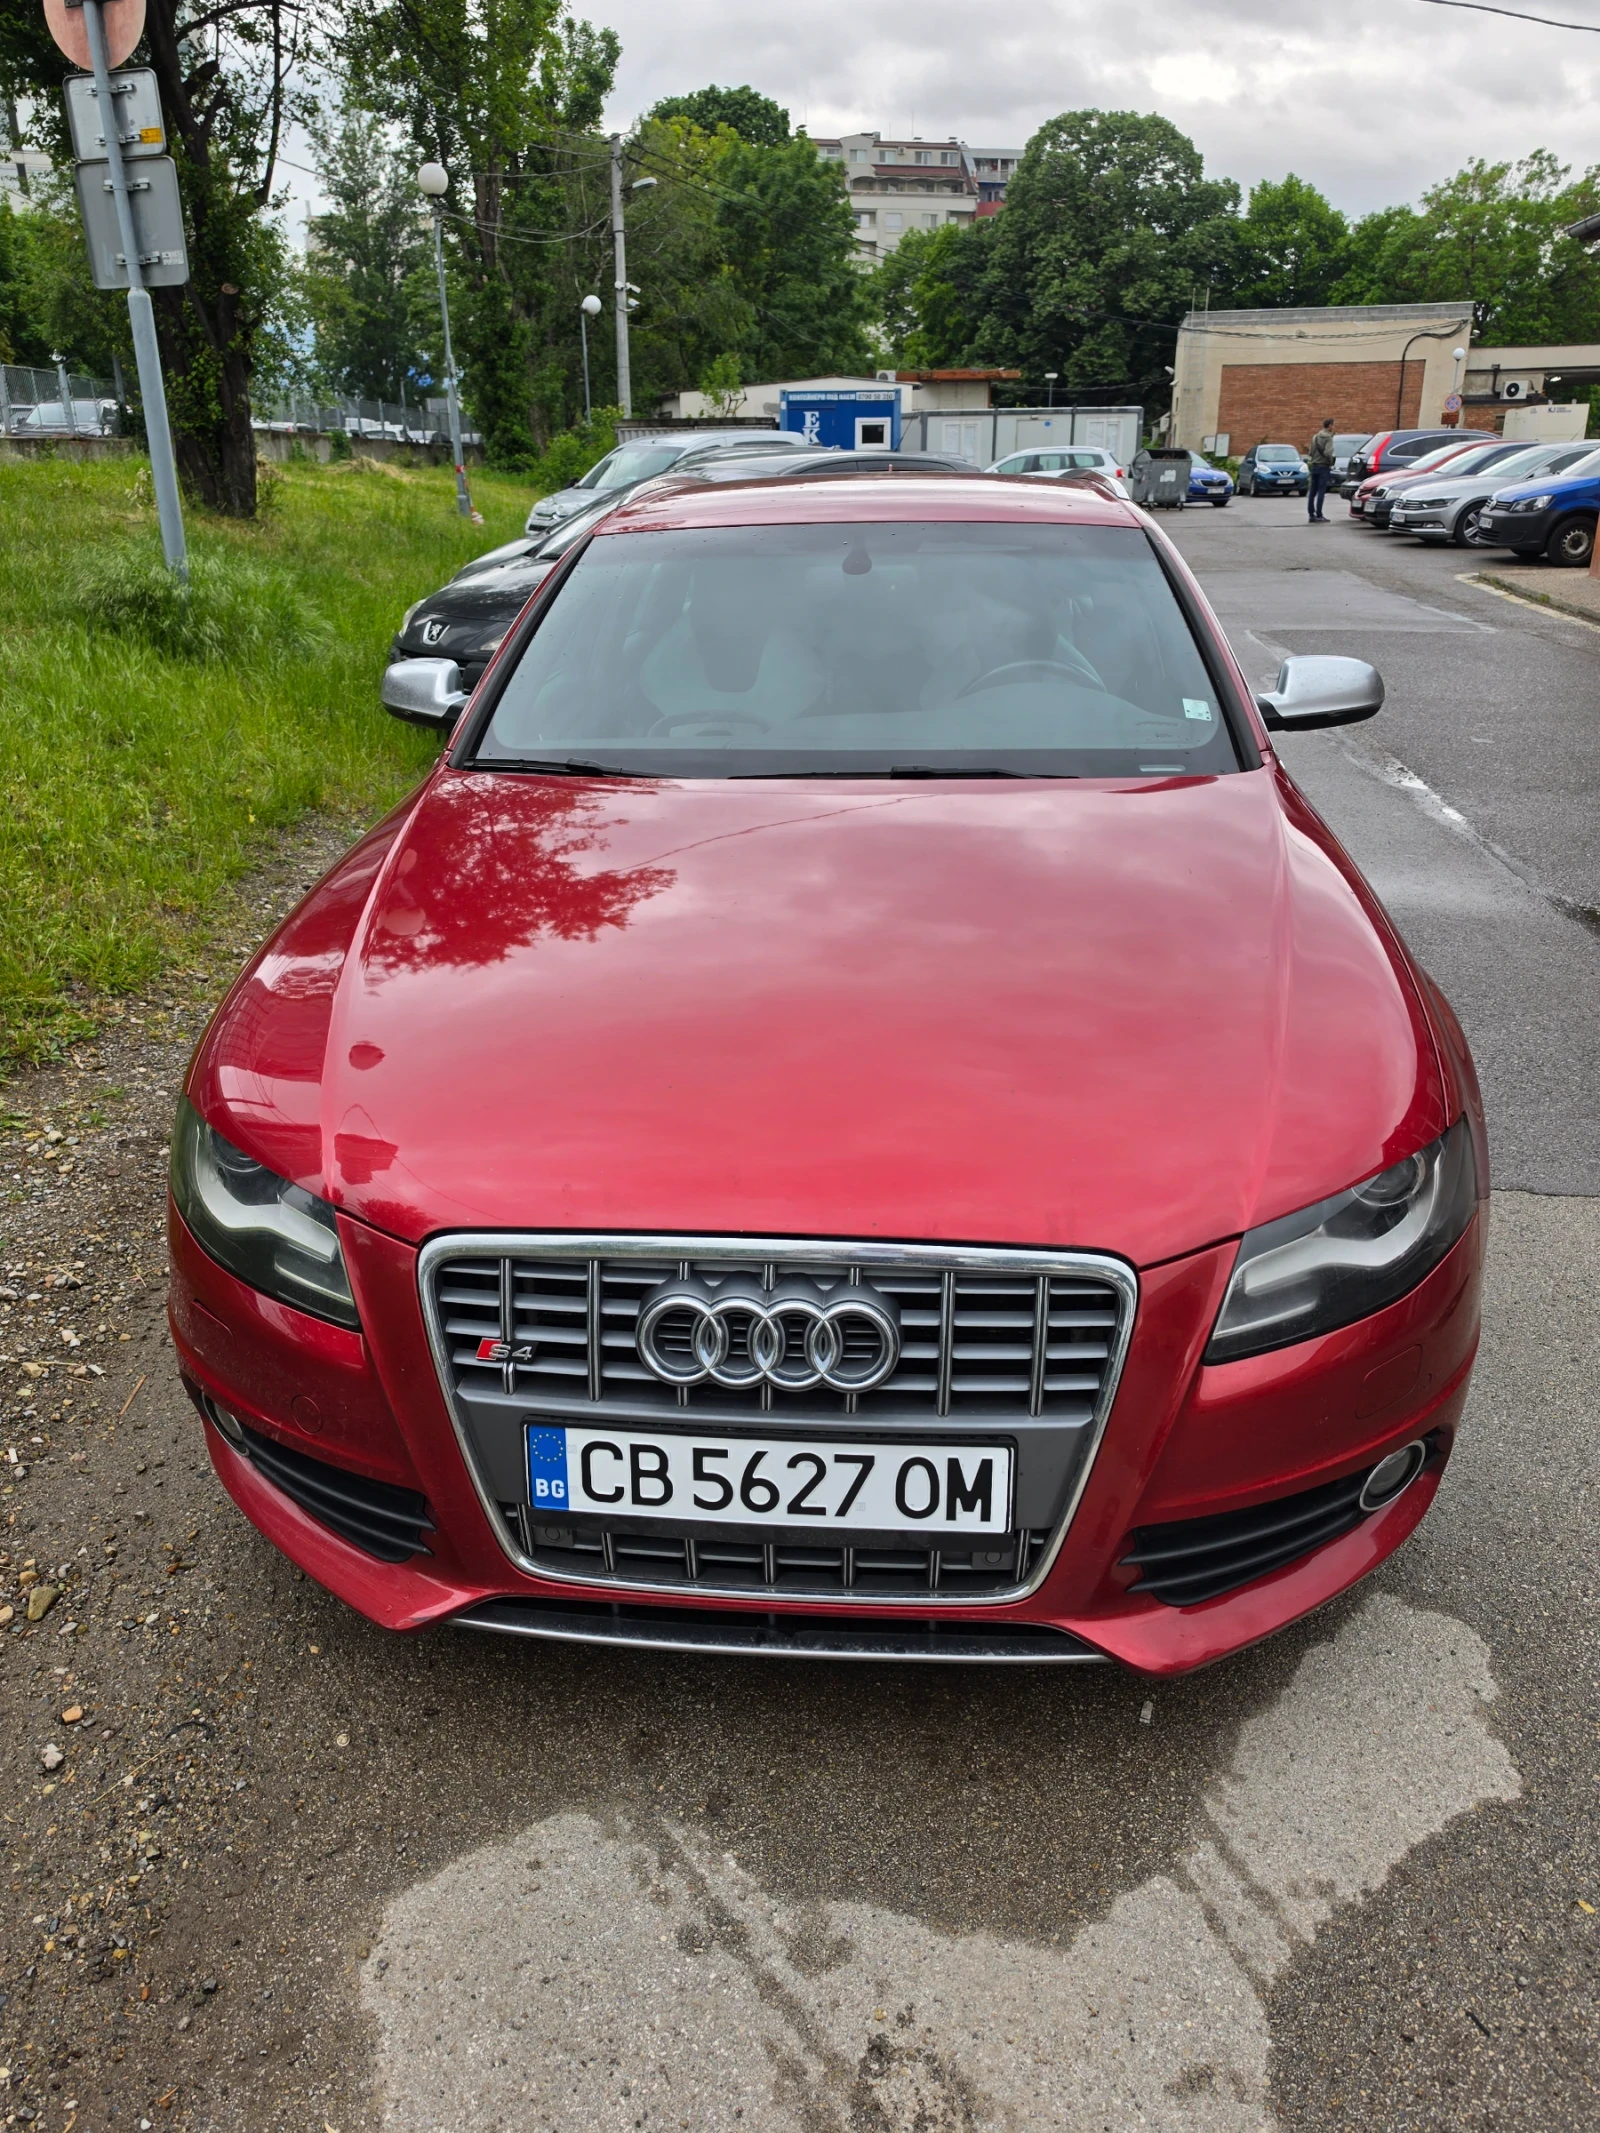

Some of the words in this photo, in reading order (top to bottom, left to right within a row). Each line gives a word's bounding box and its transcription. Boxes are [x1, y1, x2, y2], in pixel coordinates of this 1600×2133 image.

[489, 1343, 532, 1361] S4
[536, 1478, 565, 1498] BG
[581, 1440, 674, 1506] CB
[692, 1447, 875, 1517] 5627
[895, 1456, 993, 1522] OM
